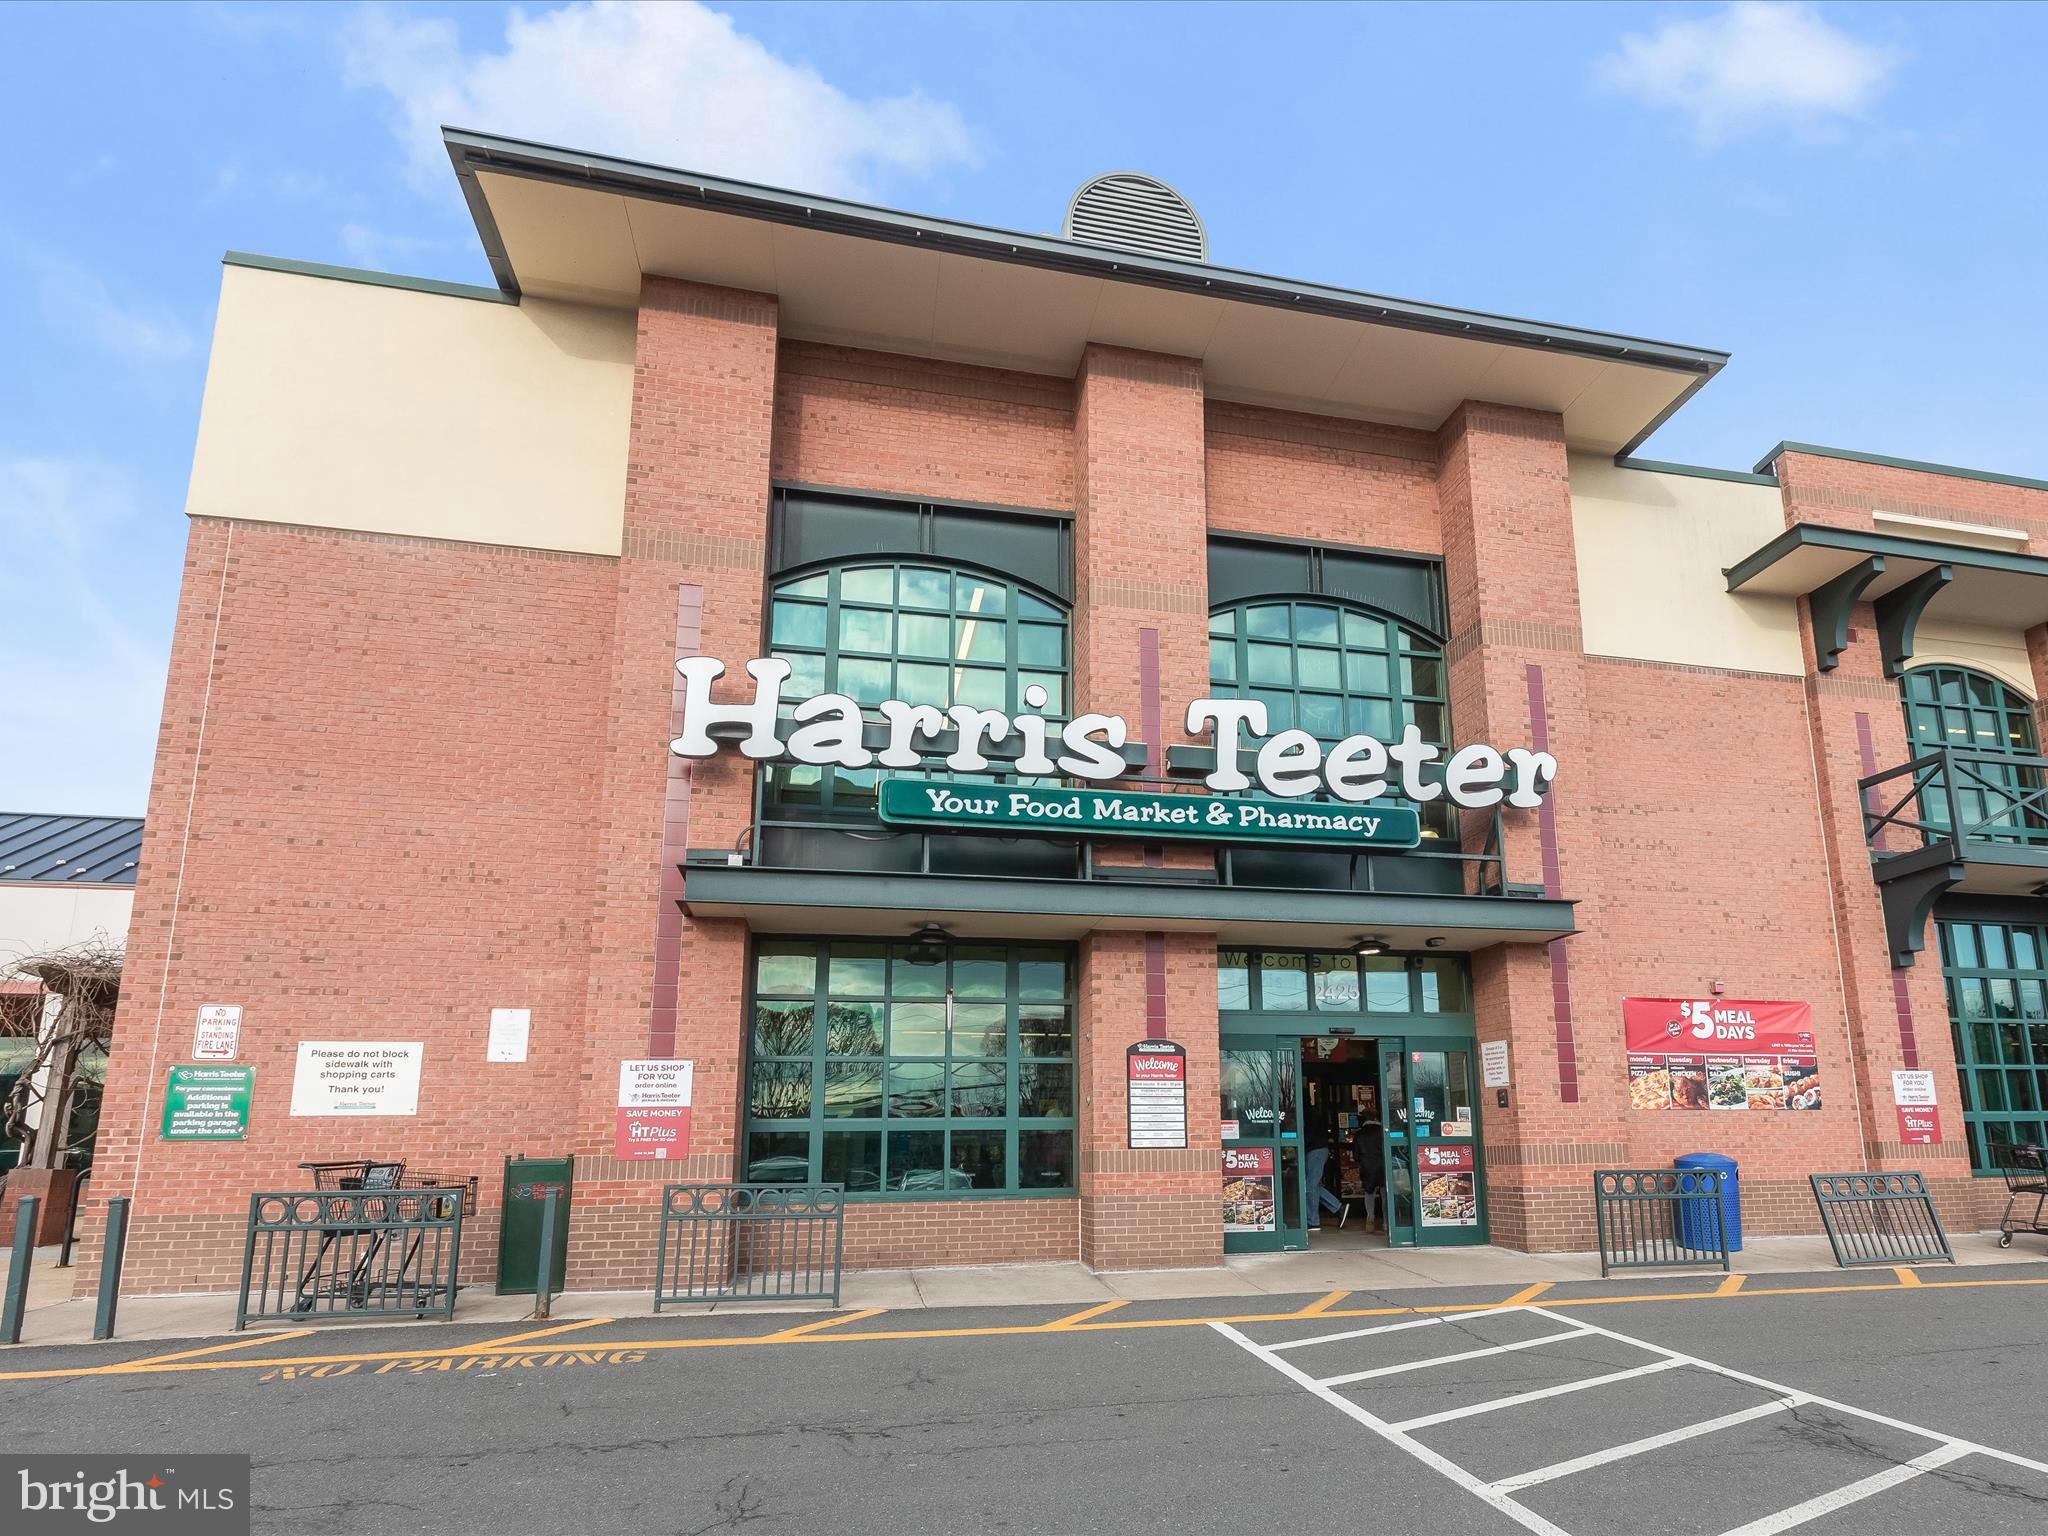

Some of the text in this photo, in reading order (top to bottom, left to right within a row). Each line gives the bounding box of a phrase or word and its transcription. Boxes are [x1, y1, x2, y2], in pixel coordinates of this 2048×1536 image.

[668, 656, 1559, 809] Harris Teeter
[925, 788, 1382, 837] Your Food Market & Pharmacy
[1225, 952, 1351, 970] Wecome to
[1315, 984, 1361, 1000] 2425
[215, 1009, 227, 1017] NO
[201, 1018, 237, 1026] PARKING
[1680, 1000, 1715, 1040] $5
[1714, 1010, 1756, 1025] MEAL
[201, 1031, 234, 1040] STANDING
[1716, 1025, 1756, 1040] DAYS
[197, 1040, 234, 1050] FIRE LANE
[311, 1049, 409, 1058] Please do not block
[325, 1060, 393, 1068] sidewalk with
[1134, 1057, 1179, 1072] Welcome
[1629, 1056, 1654, 1064] monday
[1669, 1057, 1693, 1065] tuesday
[1708, 1056, 1739, 1065] wednesday
[1745, 1056, 1771, 1065] thursday
[1782, 1057, 1800, 1066] friday
[194, 1070, 247, 1078] Harris Teeter
[320, 1071, 395, 1080] shopping carts
[328, 1085, 385, 1095] Thank you!
[187, 1102, 219, 1110] parking
[174, 1110, 213, 1118] available
[224, 1110, 239, 1118] the
[1245, 1107, 1286, 1120] Welcoe
[172, 1119, 206, 1127] parking
[170, 1127, 196, 1135] under
[198, 1127, 212, 1135] the
[1424, 1147, 1441, 1165] $5
[260, 1350, 648, 1381] NO PARKING
